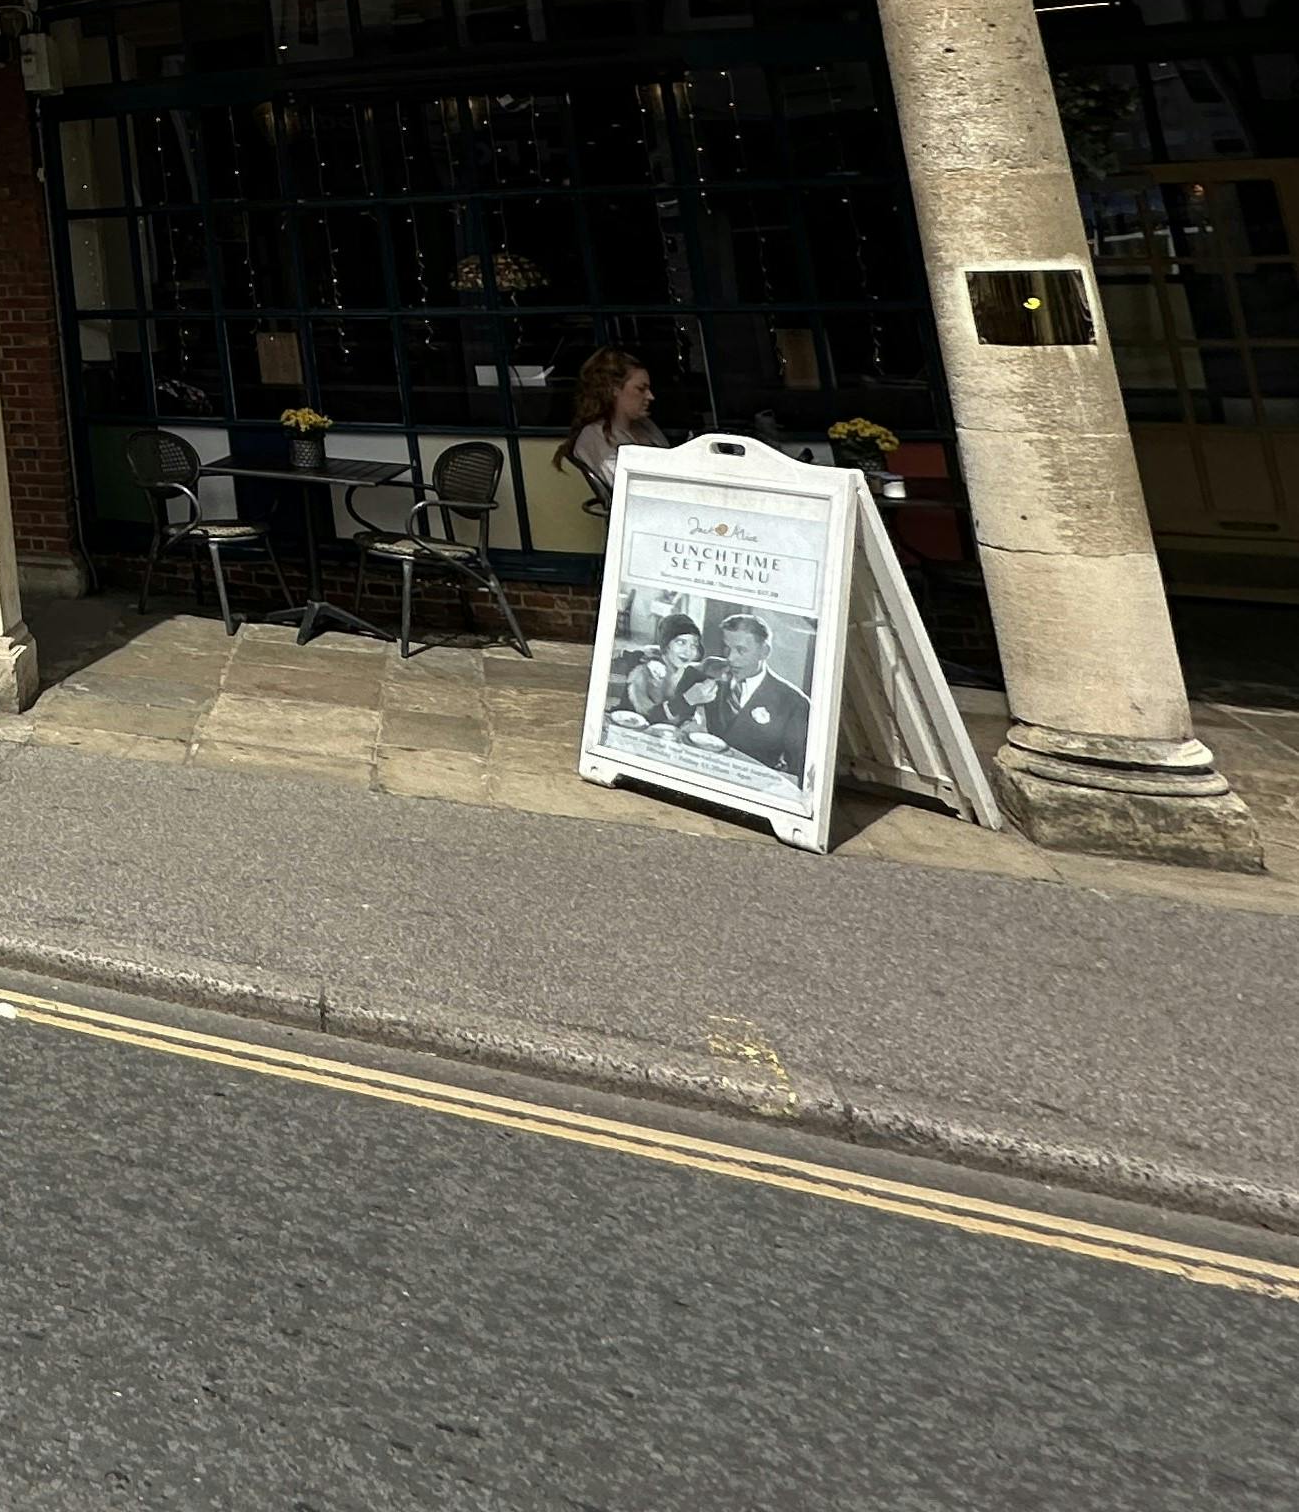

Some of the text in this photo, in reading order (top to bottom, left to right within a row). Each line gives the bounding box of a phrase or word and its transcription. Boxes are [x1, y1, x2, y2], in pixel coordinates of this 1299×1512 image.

[663, 540, 781, 572] LUNCHTIME
[670, 556, 770, 584] SET MENU
